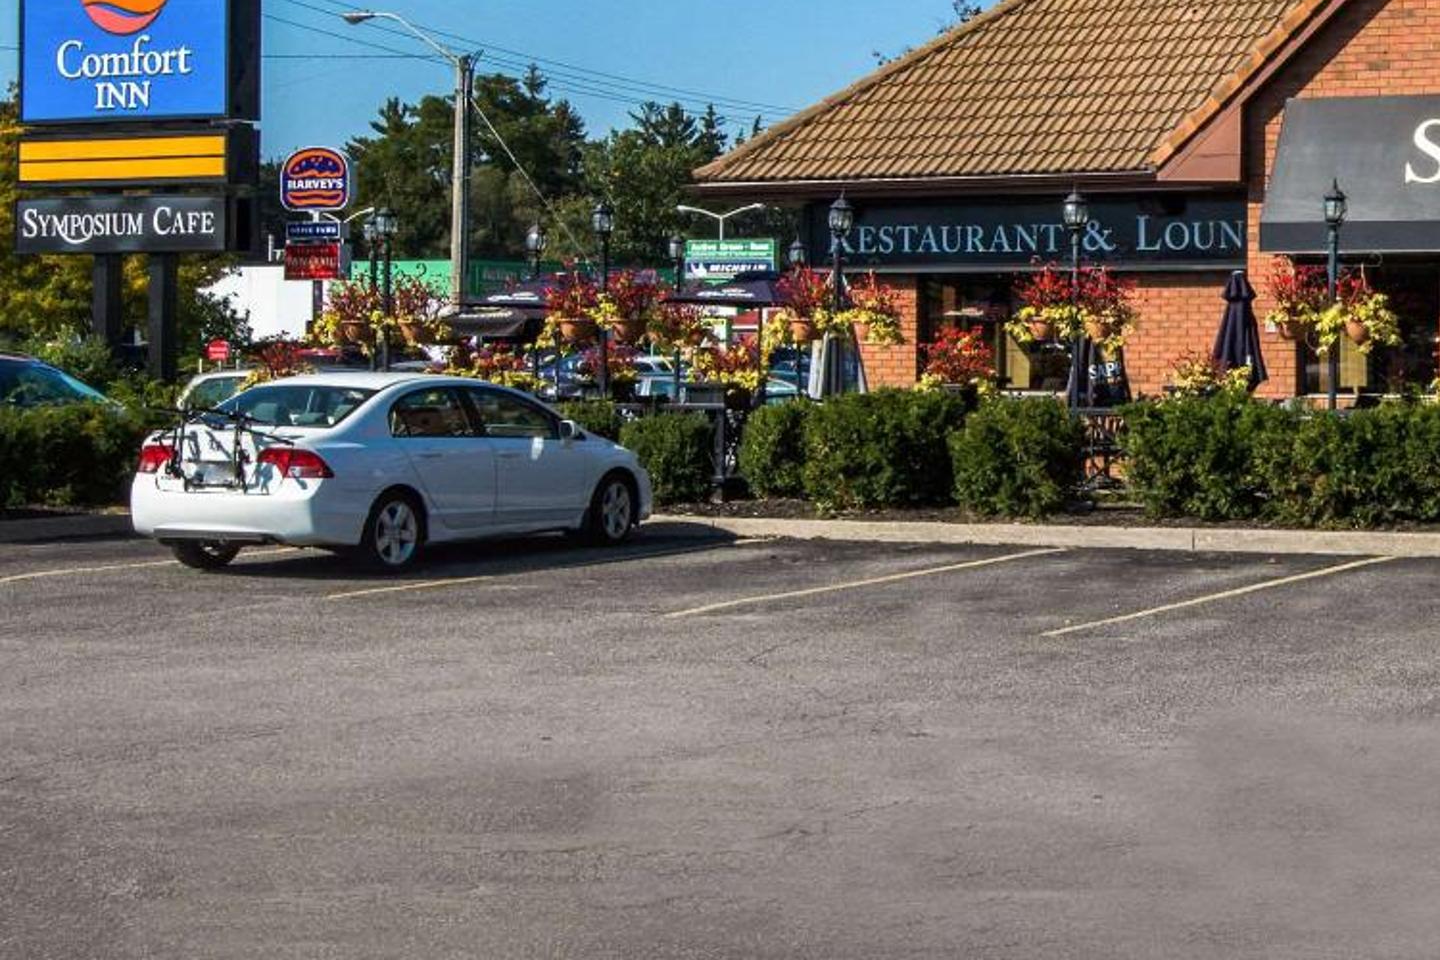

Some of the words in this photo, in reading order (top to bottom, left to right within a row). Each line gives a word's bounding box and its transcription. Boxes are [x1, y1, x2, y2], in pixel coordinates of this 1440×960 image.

[56, 34, 191, 78] Comfort
[95, 82, 150, 108] INN
[287, 178, 344, 190] HARVEY'S
[22, 208, 143, 244] SYMPOSIUM
[153, 206, 215, 235] CAFE
[1082, 220, 1115, 251] &
[1136, 214, 1243, 251] LOUN
